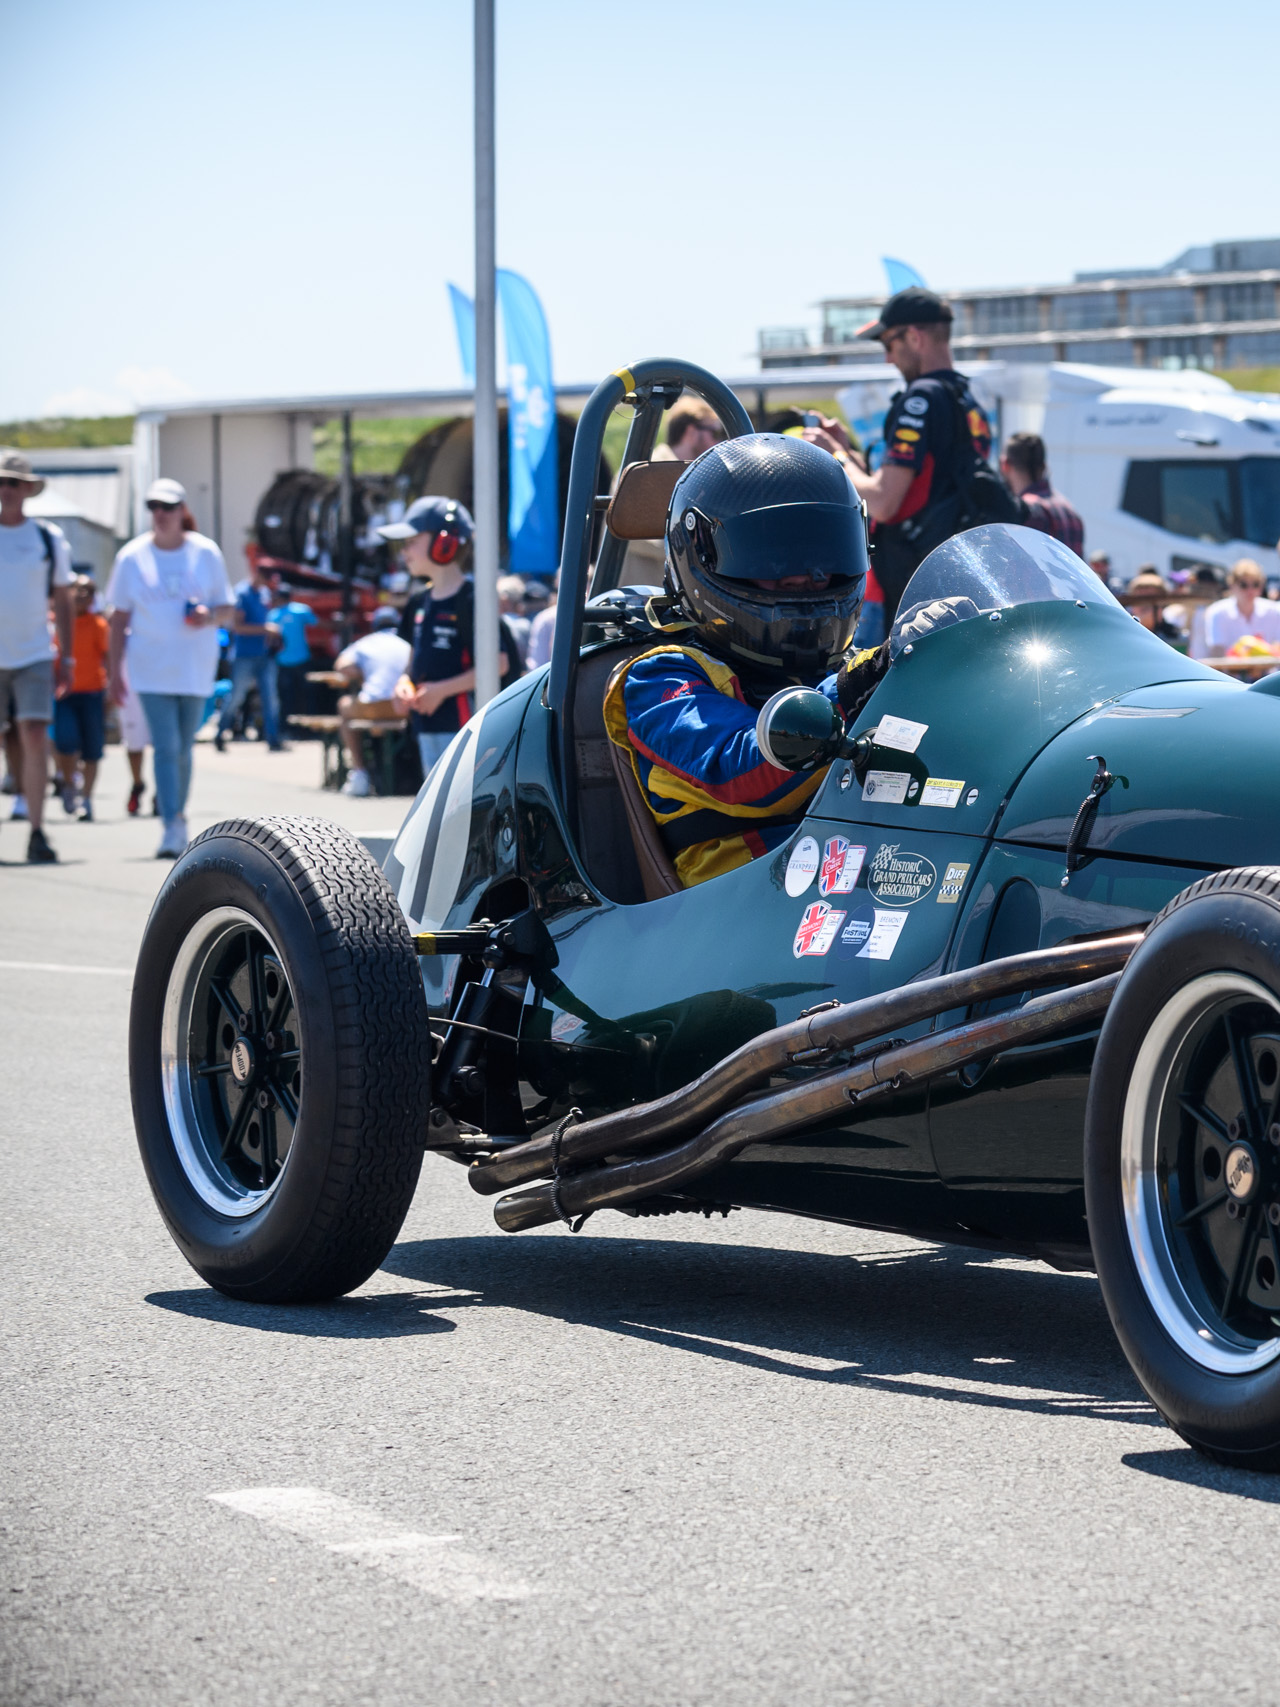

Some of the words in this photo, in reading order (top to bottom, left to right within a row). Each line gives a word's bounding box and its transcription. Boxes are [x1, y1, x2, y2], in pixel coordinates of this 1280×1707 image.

[203, 857, 244, 878] RACING
[889, 858, 923, 873] HISTORIC
[873, 869, 897, 883] GRAND
[896, 872, 914, 885] PRIX
[913, 873, 933, 887] CARS
[945, 867, 967, 881] DIFF
[876, 882, 921, 898] ASSOCIATION
